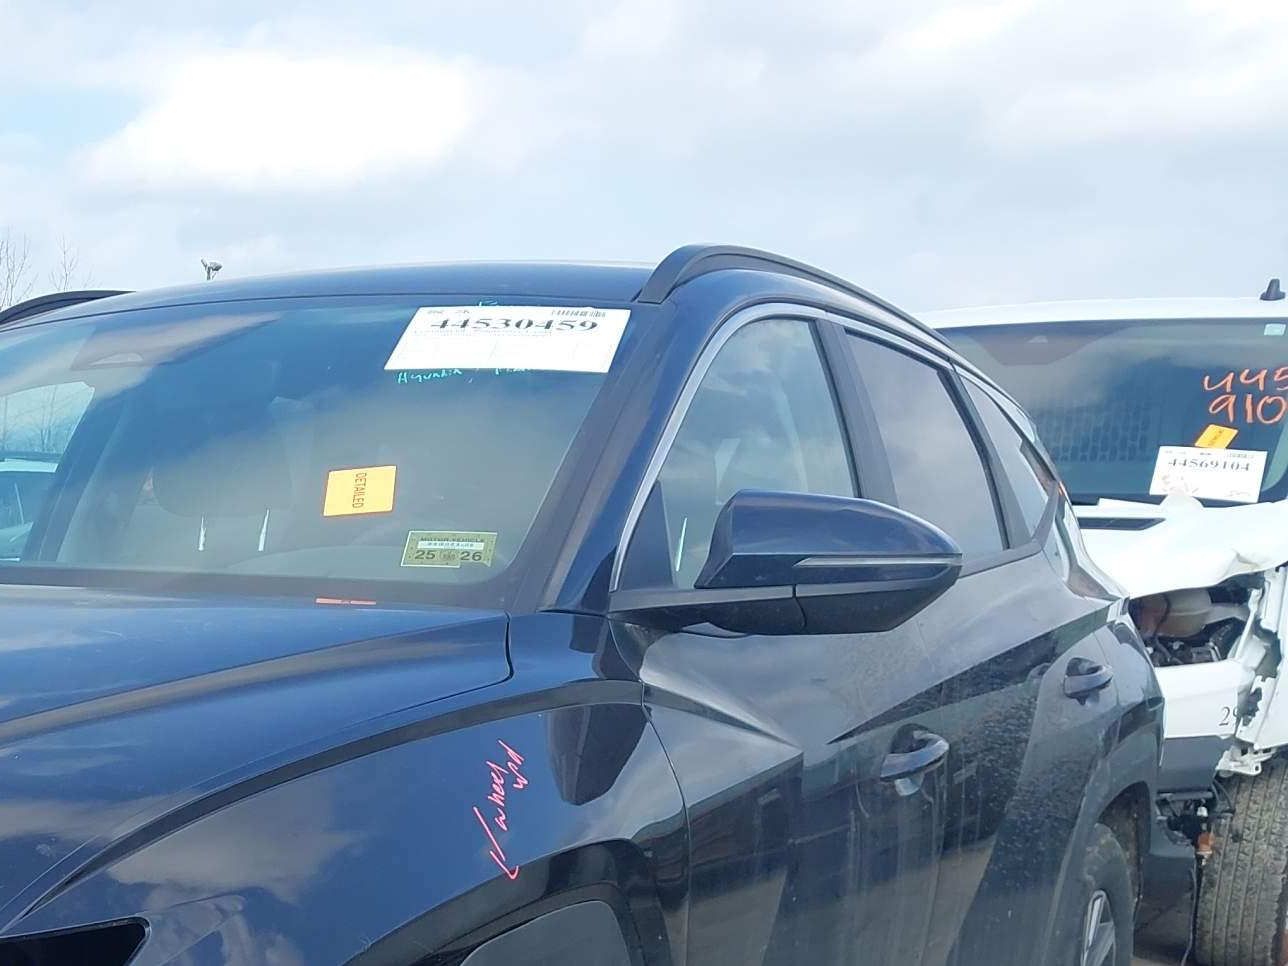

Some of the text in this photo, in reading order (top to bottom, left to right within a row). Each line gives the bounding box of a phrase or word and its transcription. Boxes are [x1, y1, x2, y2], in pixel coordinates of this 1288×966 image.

[430, 317, 599, 331] 44530459
[352, 472, 367, 509] DETAILED
[415, 549, 436, 560] 25
[460, 551, 482, 561] 26
